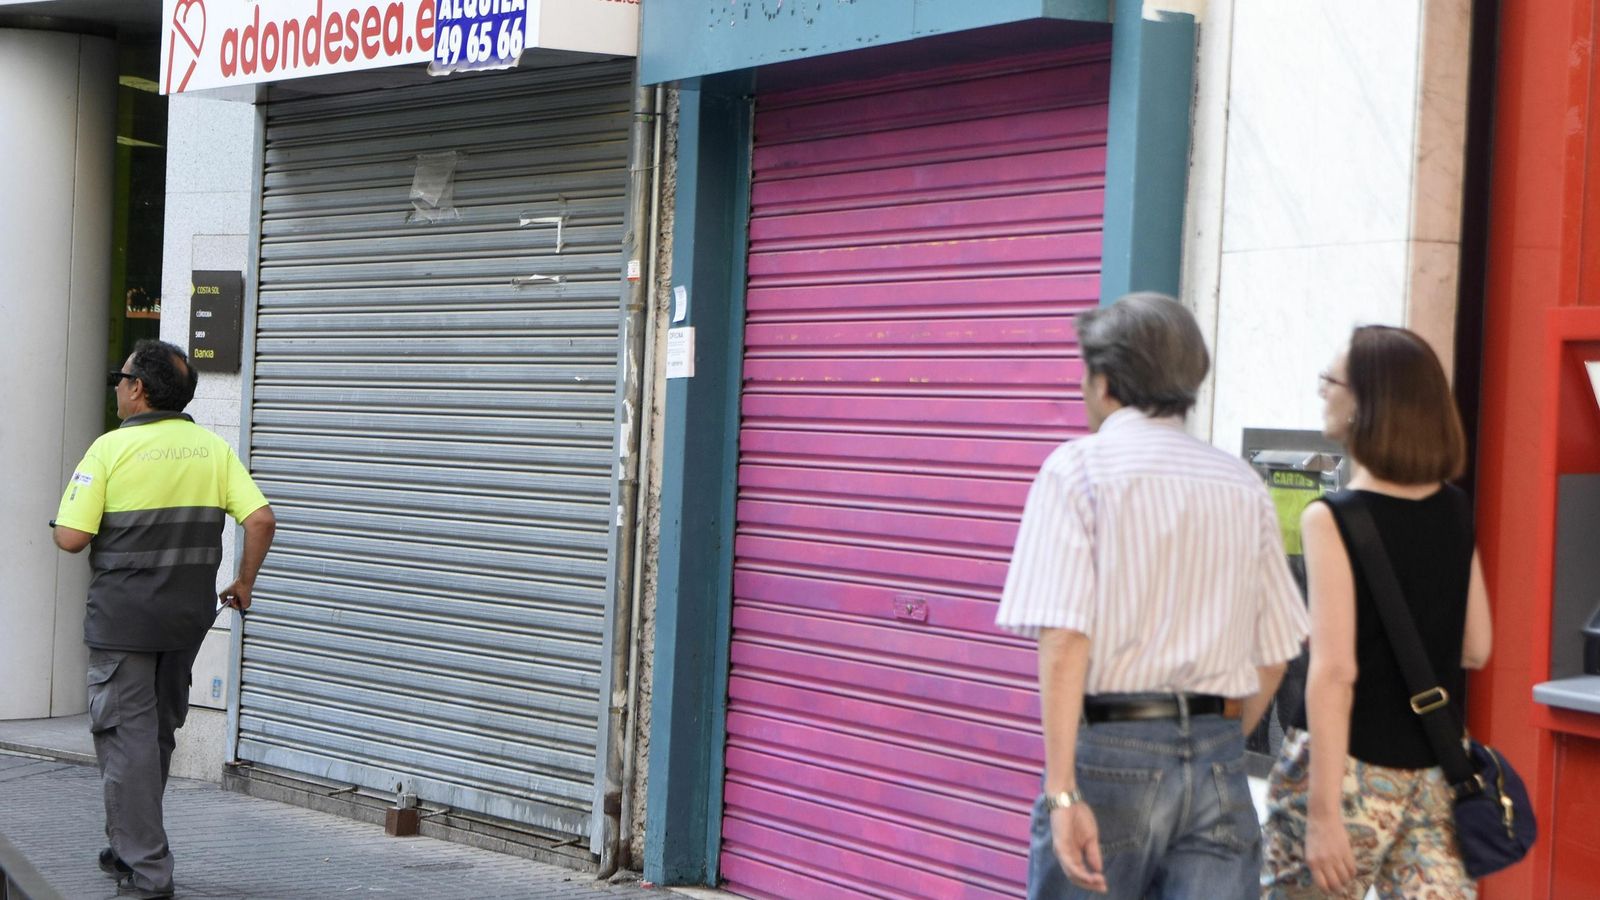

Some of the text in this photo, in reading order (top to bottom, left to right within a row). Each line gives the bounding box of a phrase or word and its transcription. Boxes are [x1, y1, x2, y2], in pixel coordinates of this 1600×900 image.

[437, 17, 524, 65] 49 65 66
[197, 286, 220, 294] COSTA SOL
[194, 348, 214, 358] Bankia
[137, 447, 209, 461] MOVILIDAD
[1273, 471, 1314, 487] CARTAS
